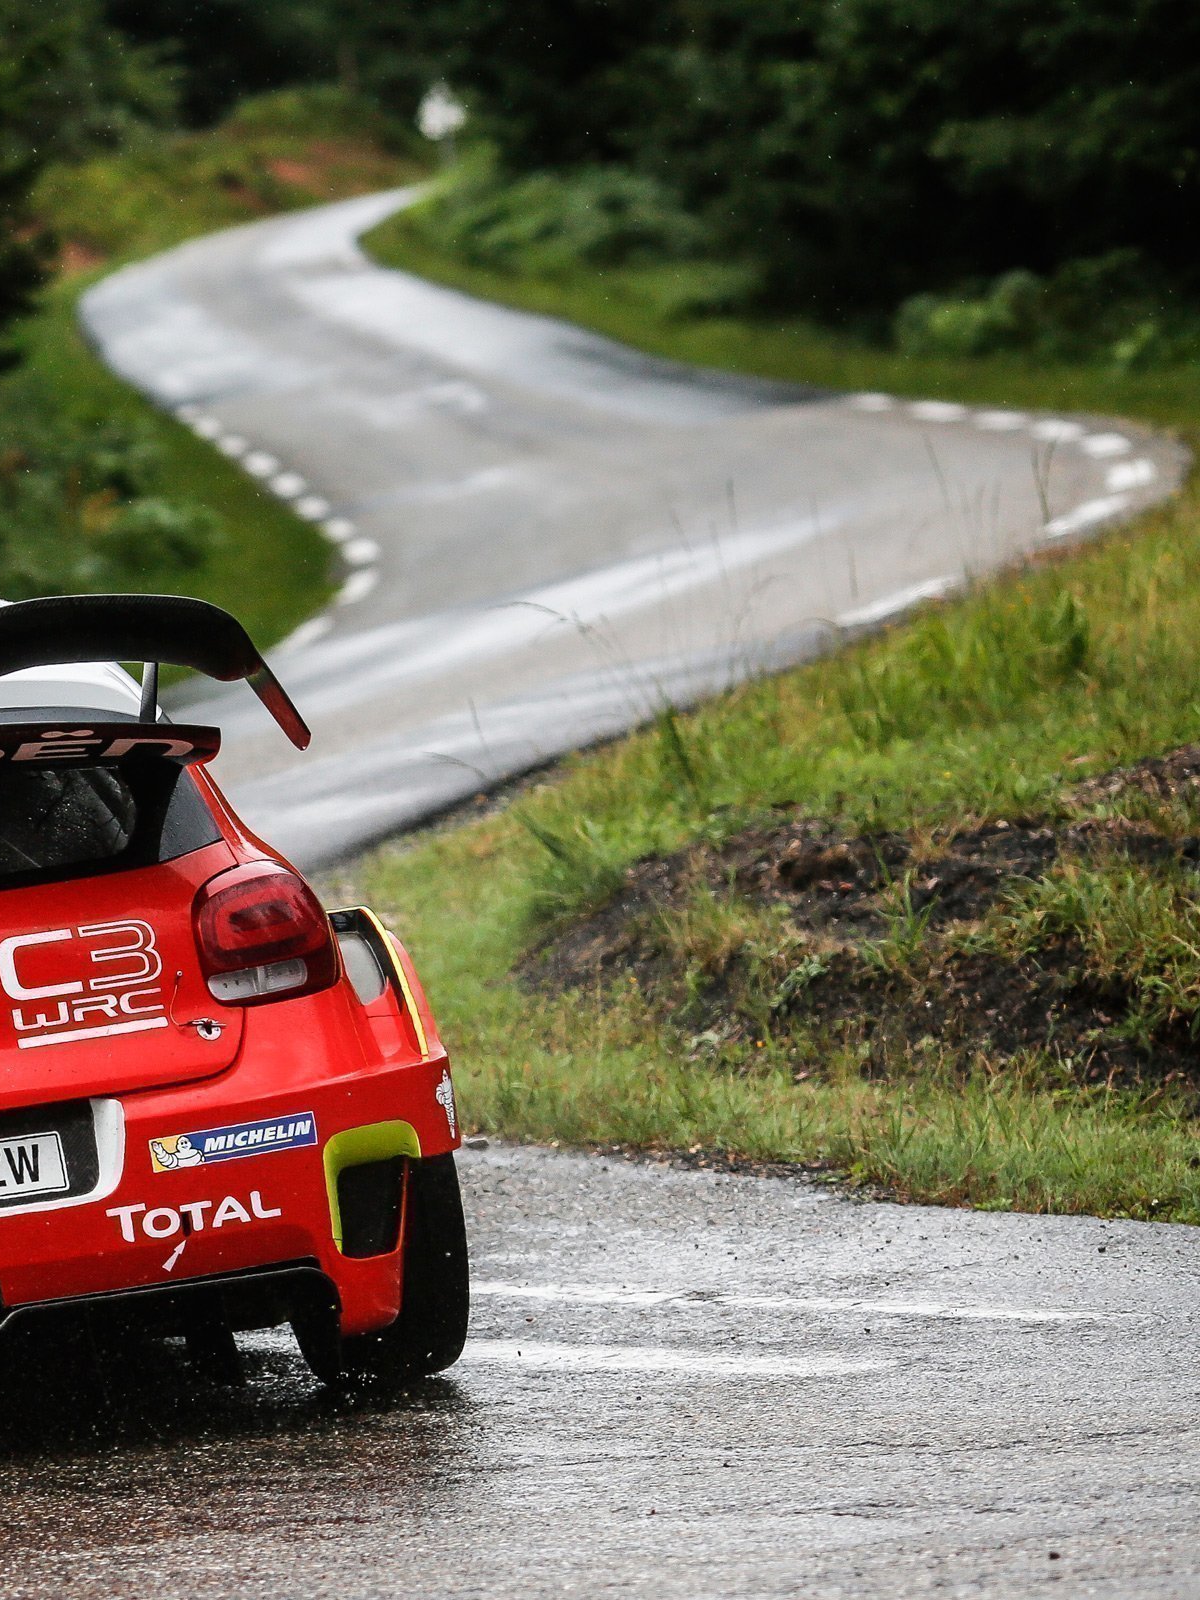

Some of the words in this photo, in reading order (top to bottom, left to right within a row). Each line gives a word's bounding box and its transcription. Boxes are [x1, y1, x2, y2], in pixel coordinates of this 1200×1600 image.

[12, 988, 165, 1031] WRC
[203, 1120, 312, 1154] MICHELIN
[105, 1190, 282, 1243] TOTAL
